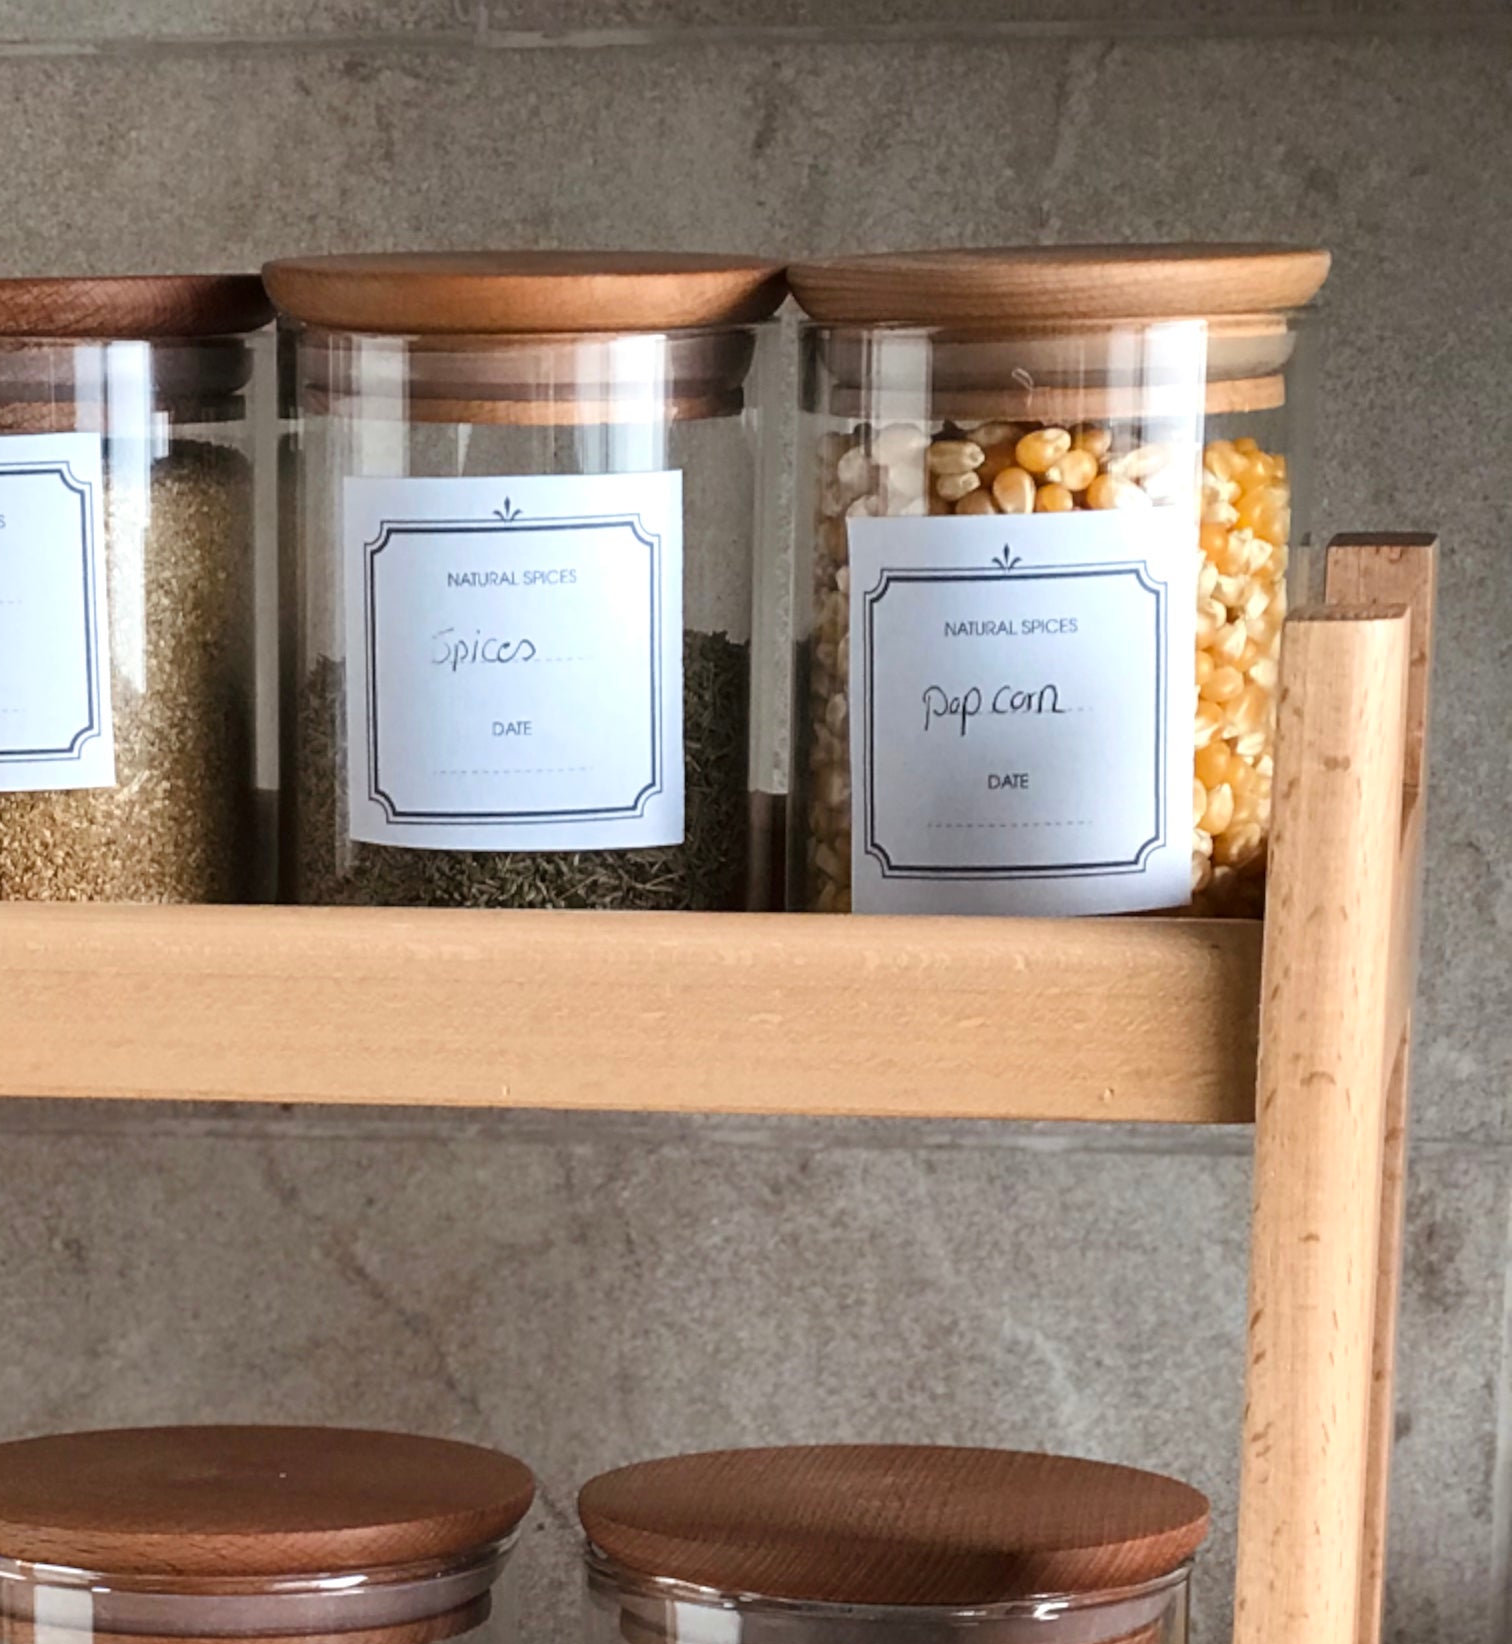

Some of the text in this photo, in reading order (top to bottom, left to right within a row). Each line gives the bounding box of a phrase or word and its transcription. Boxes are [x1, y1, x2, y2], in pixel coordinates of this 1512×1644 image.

[447, 568, 578, 588] NATURAL SPICES
[944, 617, 1079, 637] NATURAL SPICES
[431, 627, 537, 672] Spices
[492, 720, 533, 736] DATE
[987, 773, 1029, 790] DATE
